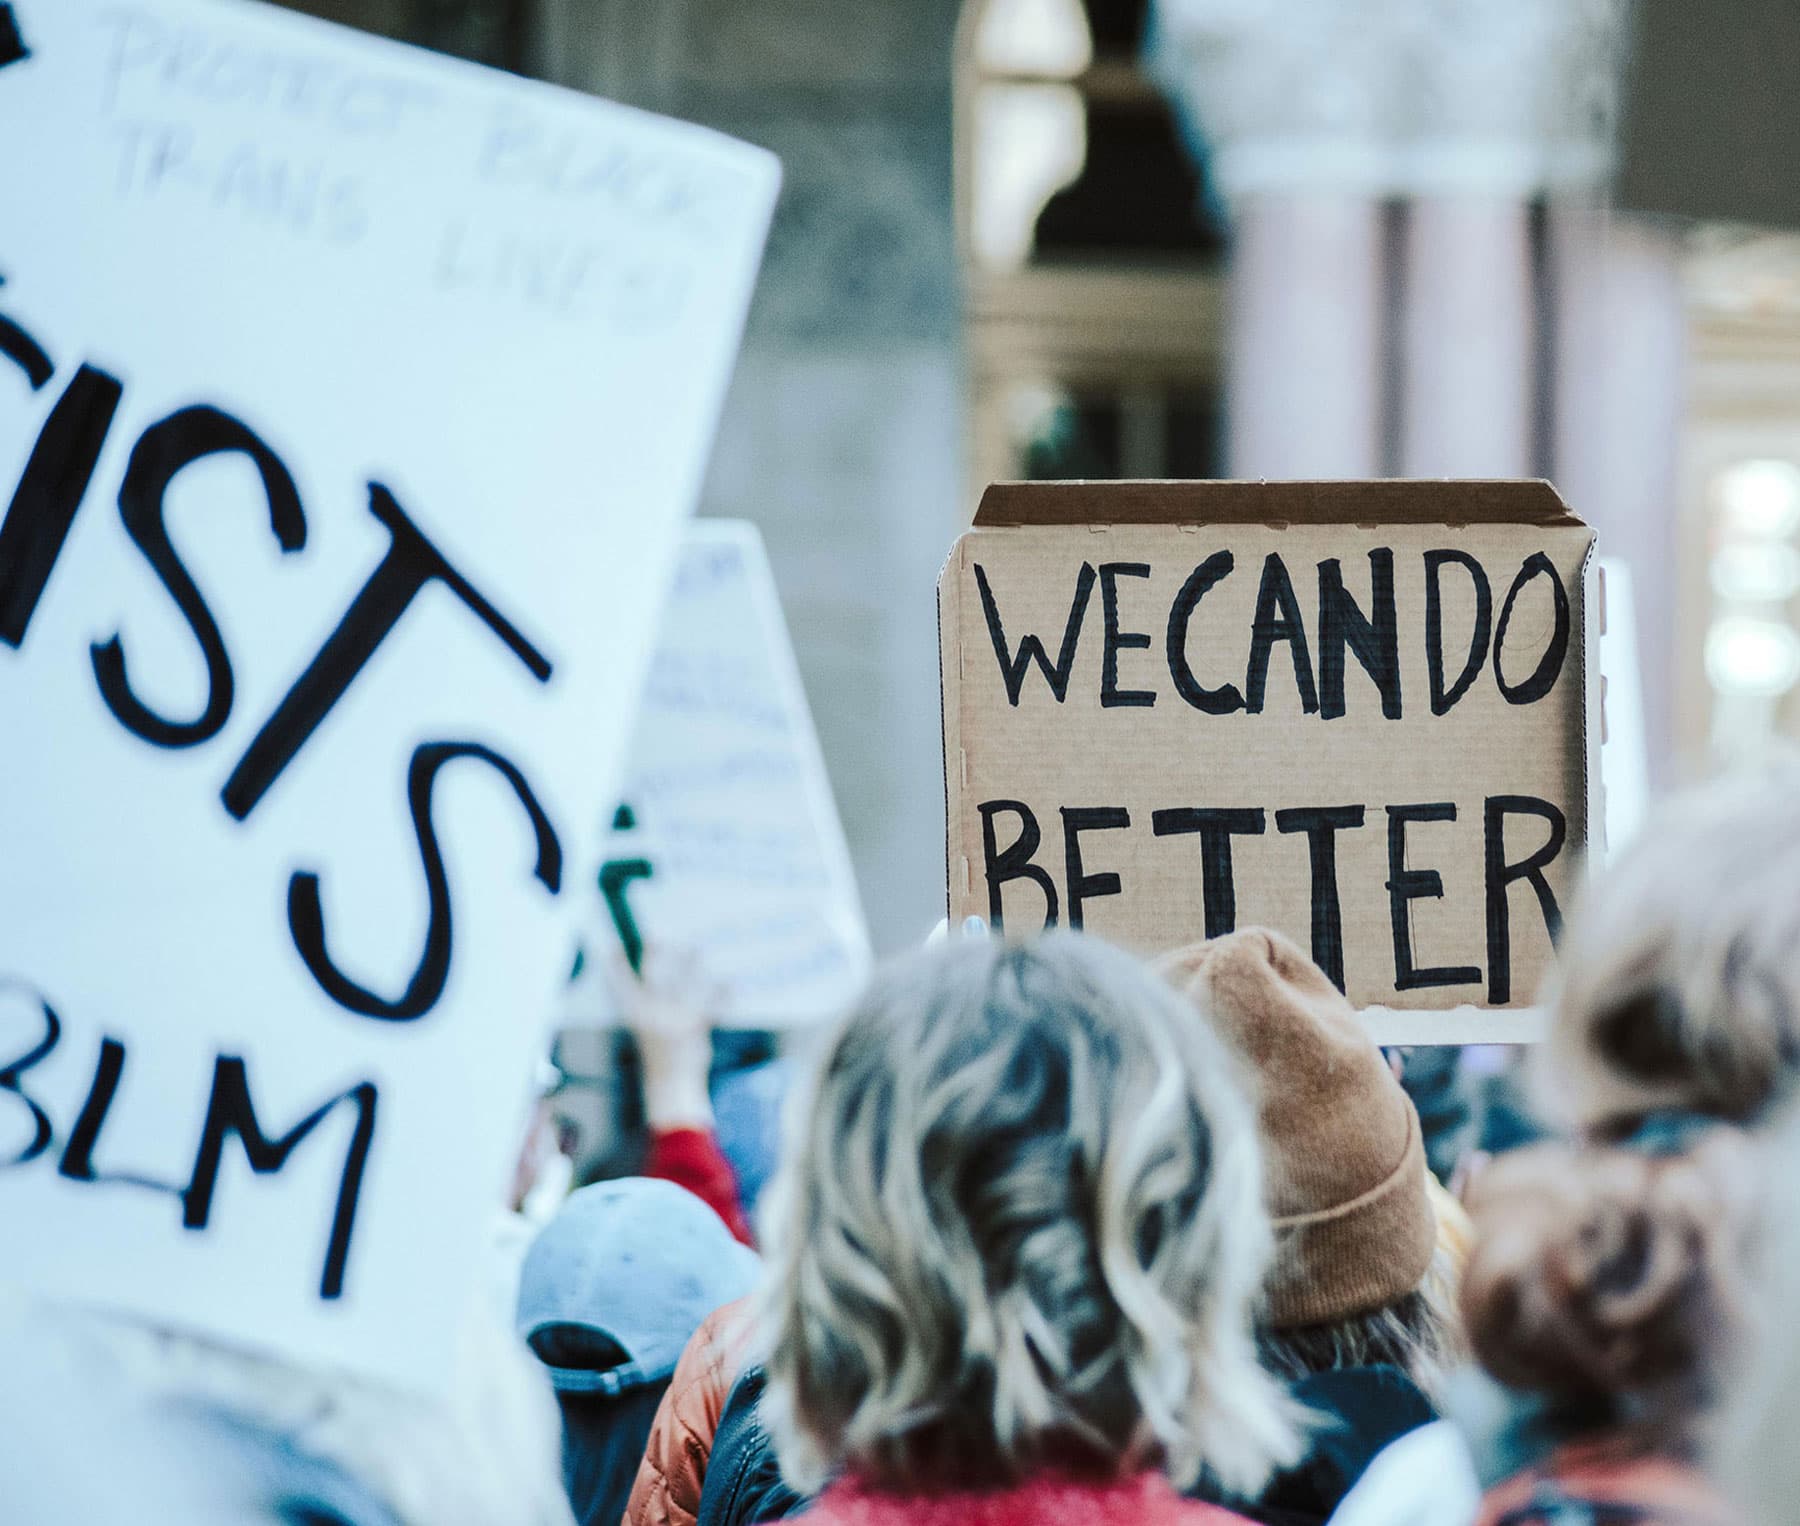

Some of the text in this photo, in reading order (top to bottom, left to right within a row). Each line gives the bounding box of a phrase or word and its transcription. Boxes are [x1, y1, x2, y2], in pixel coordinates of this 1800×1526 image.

[0, 312, 562, 1022] ISTS
[977, 795, 1567, 1004] BETTER
[0, 972, 378, 1300] BLM
